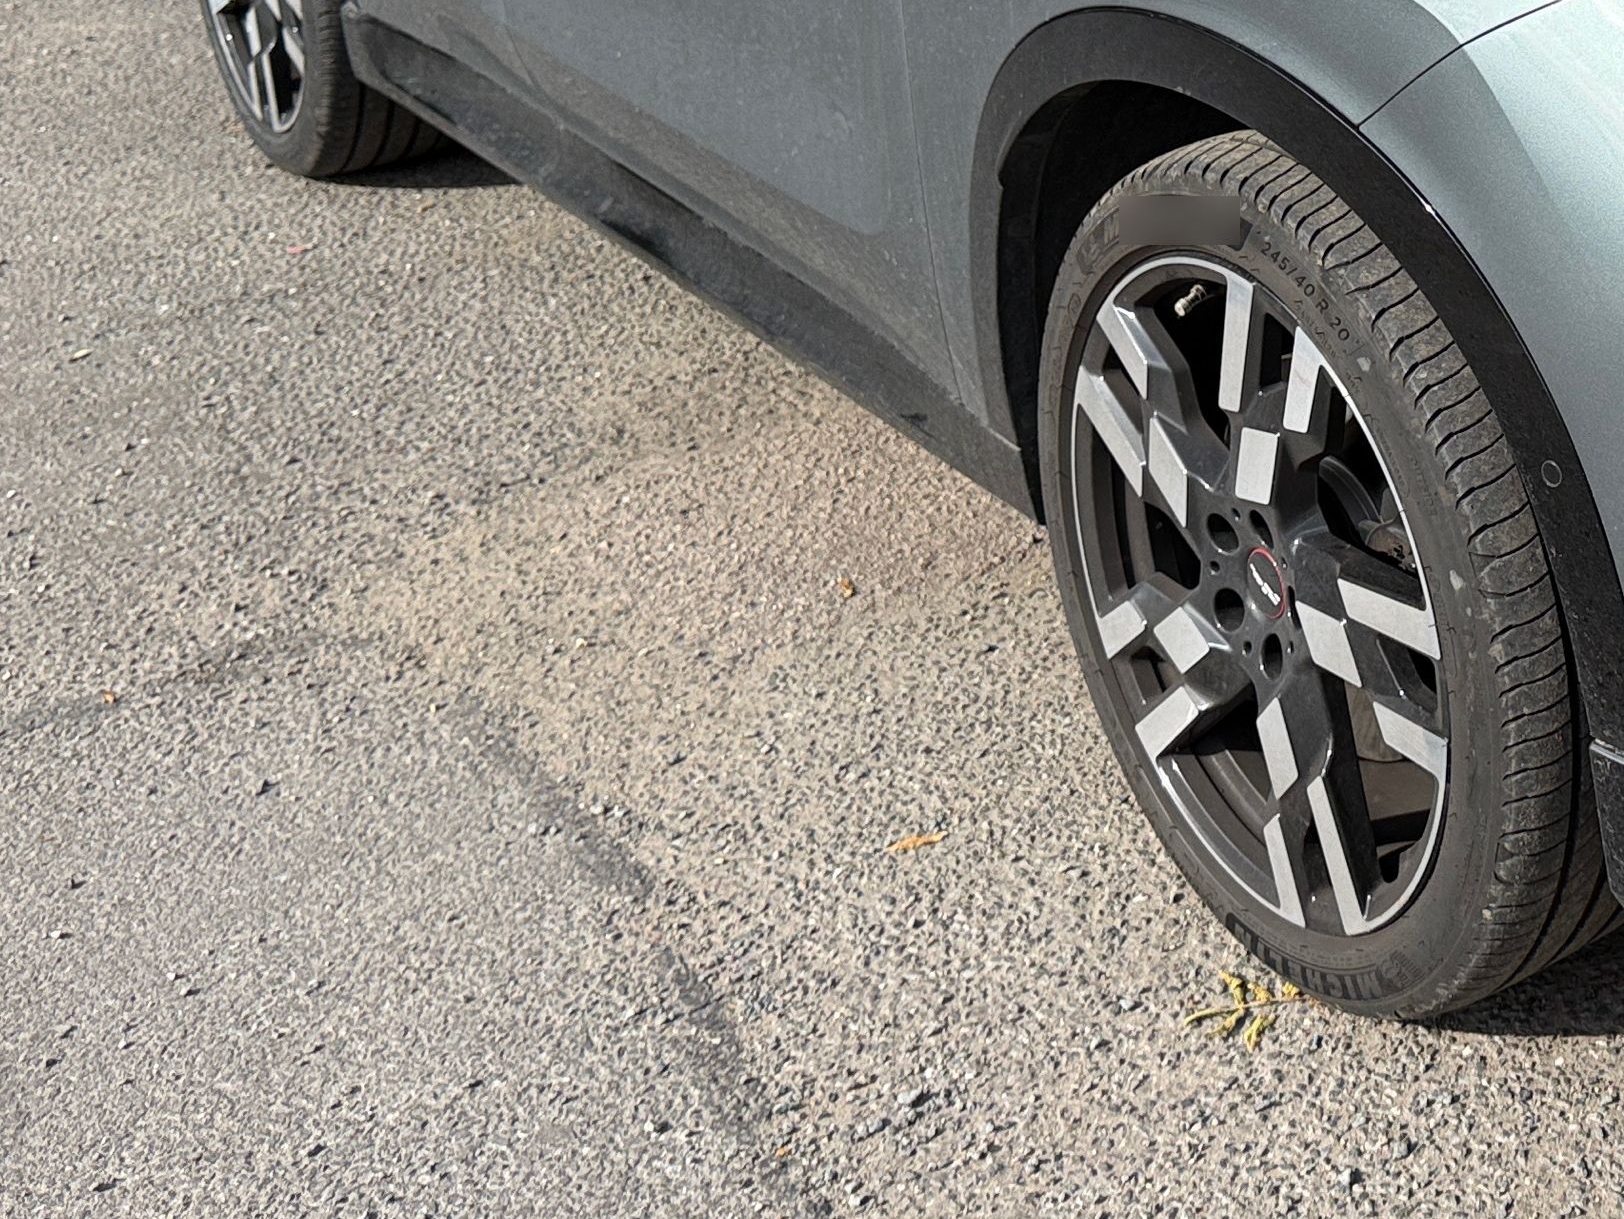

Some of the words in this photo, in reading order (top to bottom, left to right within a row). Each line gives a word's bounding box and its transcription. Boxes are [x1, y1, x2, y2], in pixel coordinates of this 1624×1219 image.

[1260, 241, 1316, 298] 245/40
[1315, 298, 1330, 315] R
[1329, 316, 1350, 342] 20
